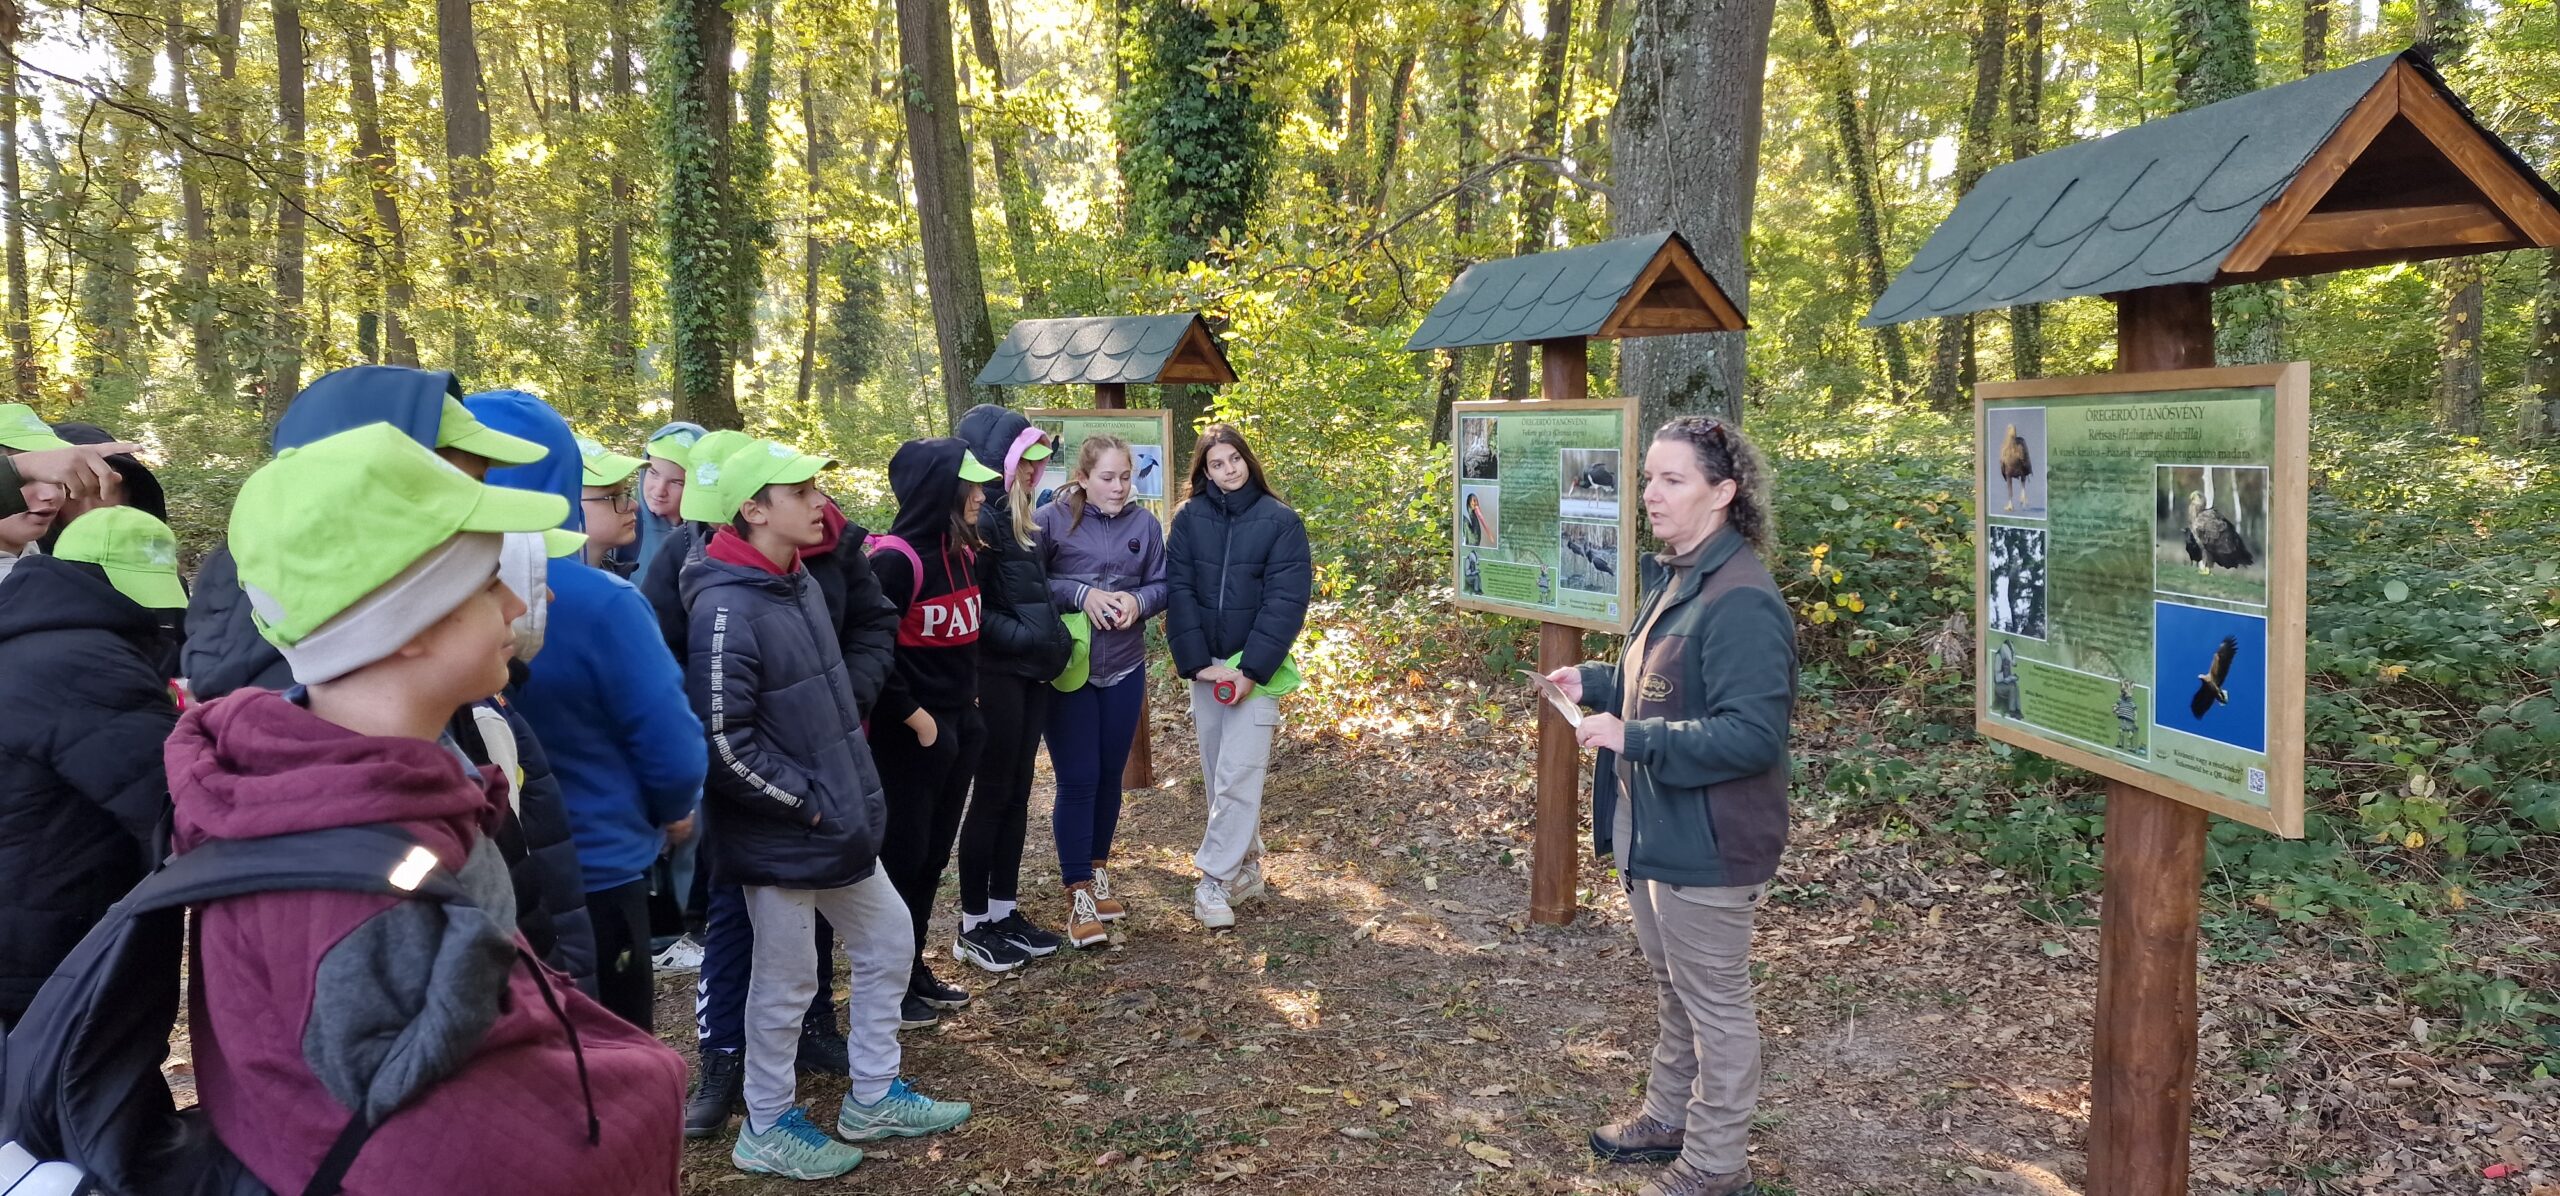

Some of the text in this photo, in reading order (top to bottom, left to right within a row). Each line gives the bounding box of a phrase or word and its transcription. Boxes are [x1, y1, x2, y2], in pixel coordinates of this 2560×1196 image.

[714, 613, 728, 632] STAY
[711, 654, 723, 691] ORIGINAL
[711, 693, 723, 711] STAY
[729, 760, 751, 778] STAY
